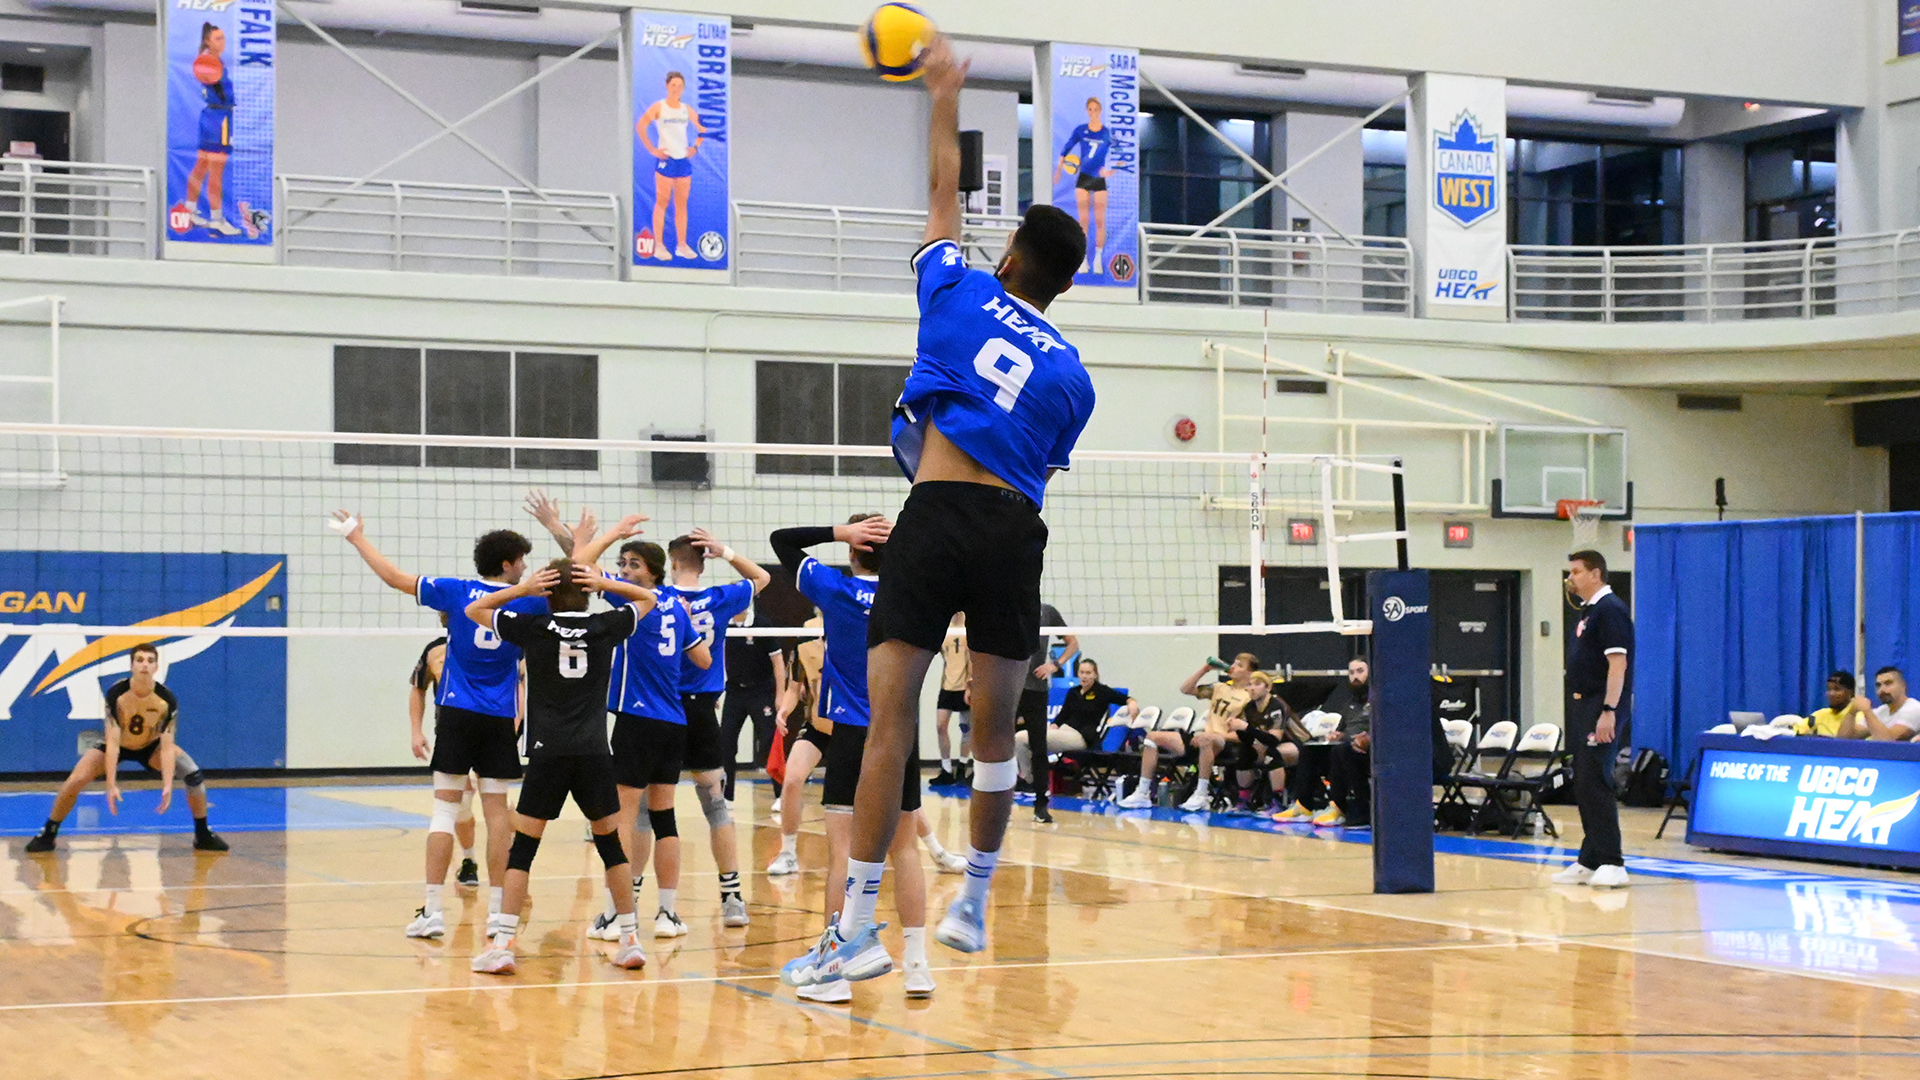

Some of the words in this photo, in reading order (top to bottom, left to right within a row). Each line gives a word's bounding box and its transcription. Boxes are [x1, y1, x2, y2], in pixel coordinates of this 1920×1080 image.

[239, 8, 272, 67] FALK
[642, 33, 696, 49] HEAT
[1060, 64, 1107, 78] HEAT
[1110, 54, 1137, 71] SARA
[697, 44, 727, 142] BRAWDY
[1087, 141, 1100, 159] 7
[1439, 151, 1494, 174] CANADA
[1440, 177, 1493, 208] WEST
[1438, 268, 1478, 281] UBCO
[1435, 281, 1499, 300] HEAT
[981, 295, 1067, 354] HEAT
[973, 337, 1035, 414] 9
[1405, 605, 1429, 614] SPORT
[657, 614, 676, 657] 5
[953, 637, 960, 654] 1
[558, 640, 588, 679] 6
[1213, 698, 1231, 717] 17
[128, 714, 145, 736] 8
[1710, 761, 1746, 780] HOME
[1747, 764, 1766, 781] OF
[1766, 764, 1791, 783] THE
[1797, 764, 1880, 797] UBCO
[1784, 789, 1920, 846] HEAT
